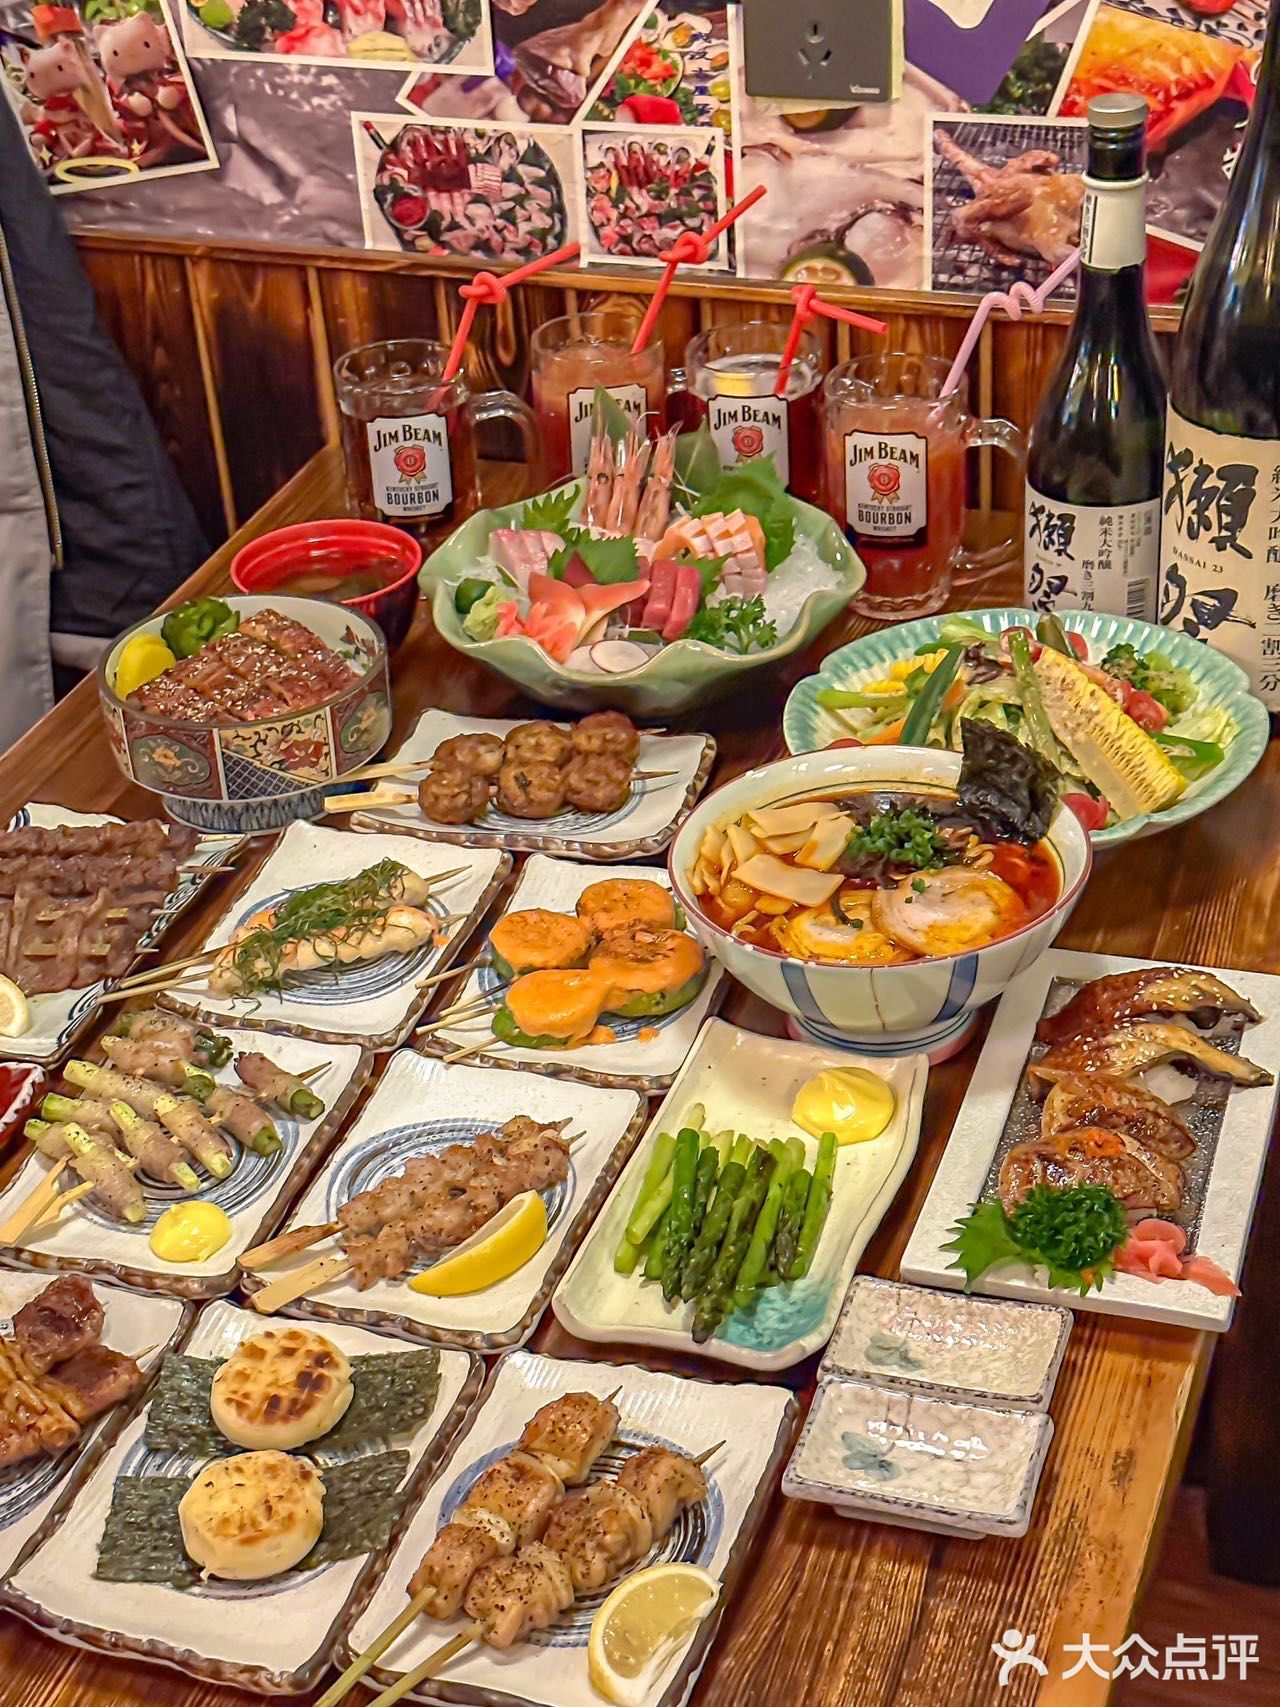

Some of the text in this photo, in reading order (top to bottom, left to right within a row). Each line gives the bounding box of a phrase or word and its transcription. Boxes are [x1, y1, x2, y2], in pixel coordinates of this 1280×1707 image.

[714, 405, 782, 430] JIM BEAM
[374, 424, 443, 452] JIM BEAM
[850, 441, 919, 469] JIM BEAM
[386, 489, 439, 505] BOURBON
[858, 509, 912, 525] BOURBON
[1212, 564, 1224, 574] 23
